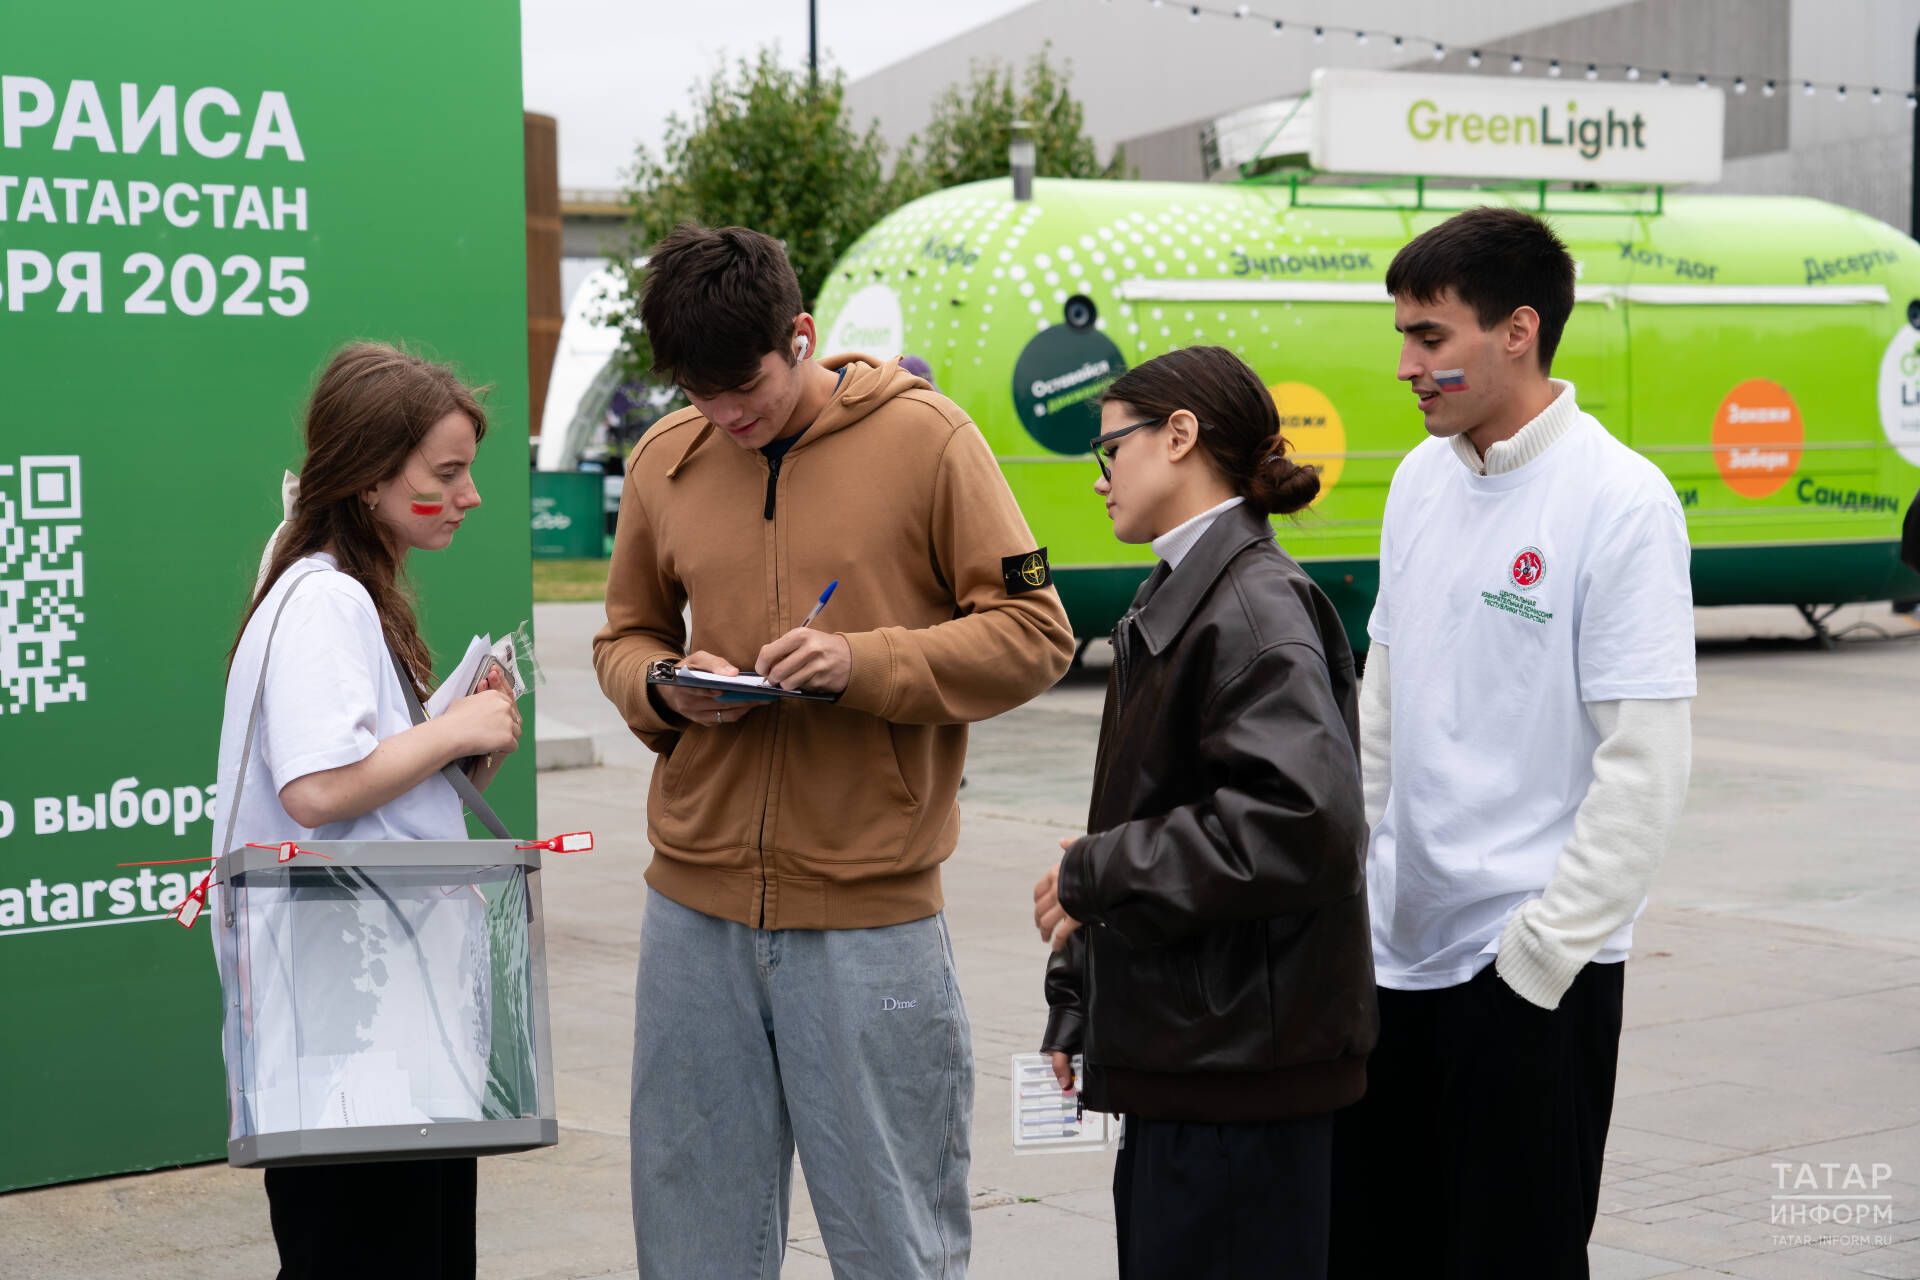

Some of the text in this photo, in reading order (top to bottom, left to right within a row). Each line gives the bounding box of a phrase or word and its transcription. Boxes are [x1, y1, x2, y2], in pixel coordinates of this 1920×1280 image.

[2, 75, 305, 161] РАИСА
[1407, 98, 1646, 160] GreenLight
[0, 175, 308, 231] ТАТАРСТАН
[0, 249, 310, 317] РЯ 2025
[1232, 250, 1374, 276] Эчпочмак
[1797, 477, 1899, 513] Сандвич
[880, 996, 917, 1010] Dime
